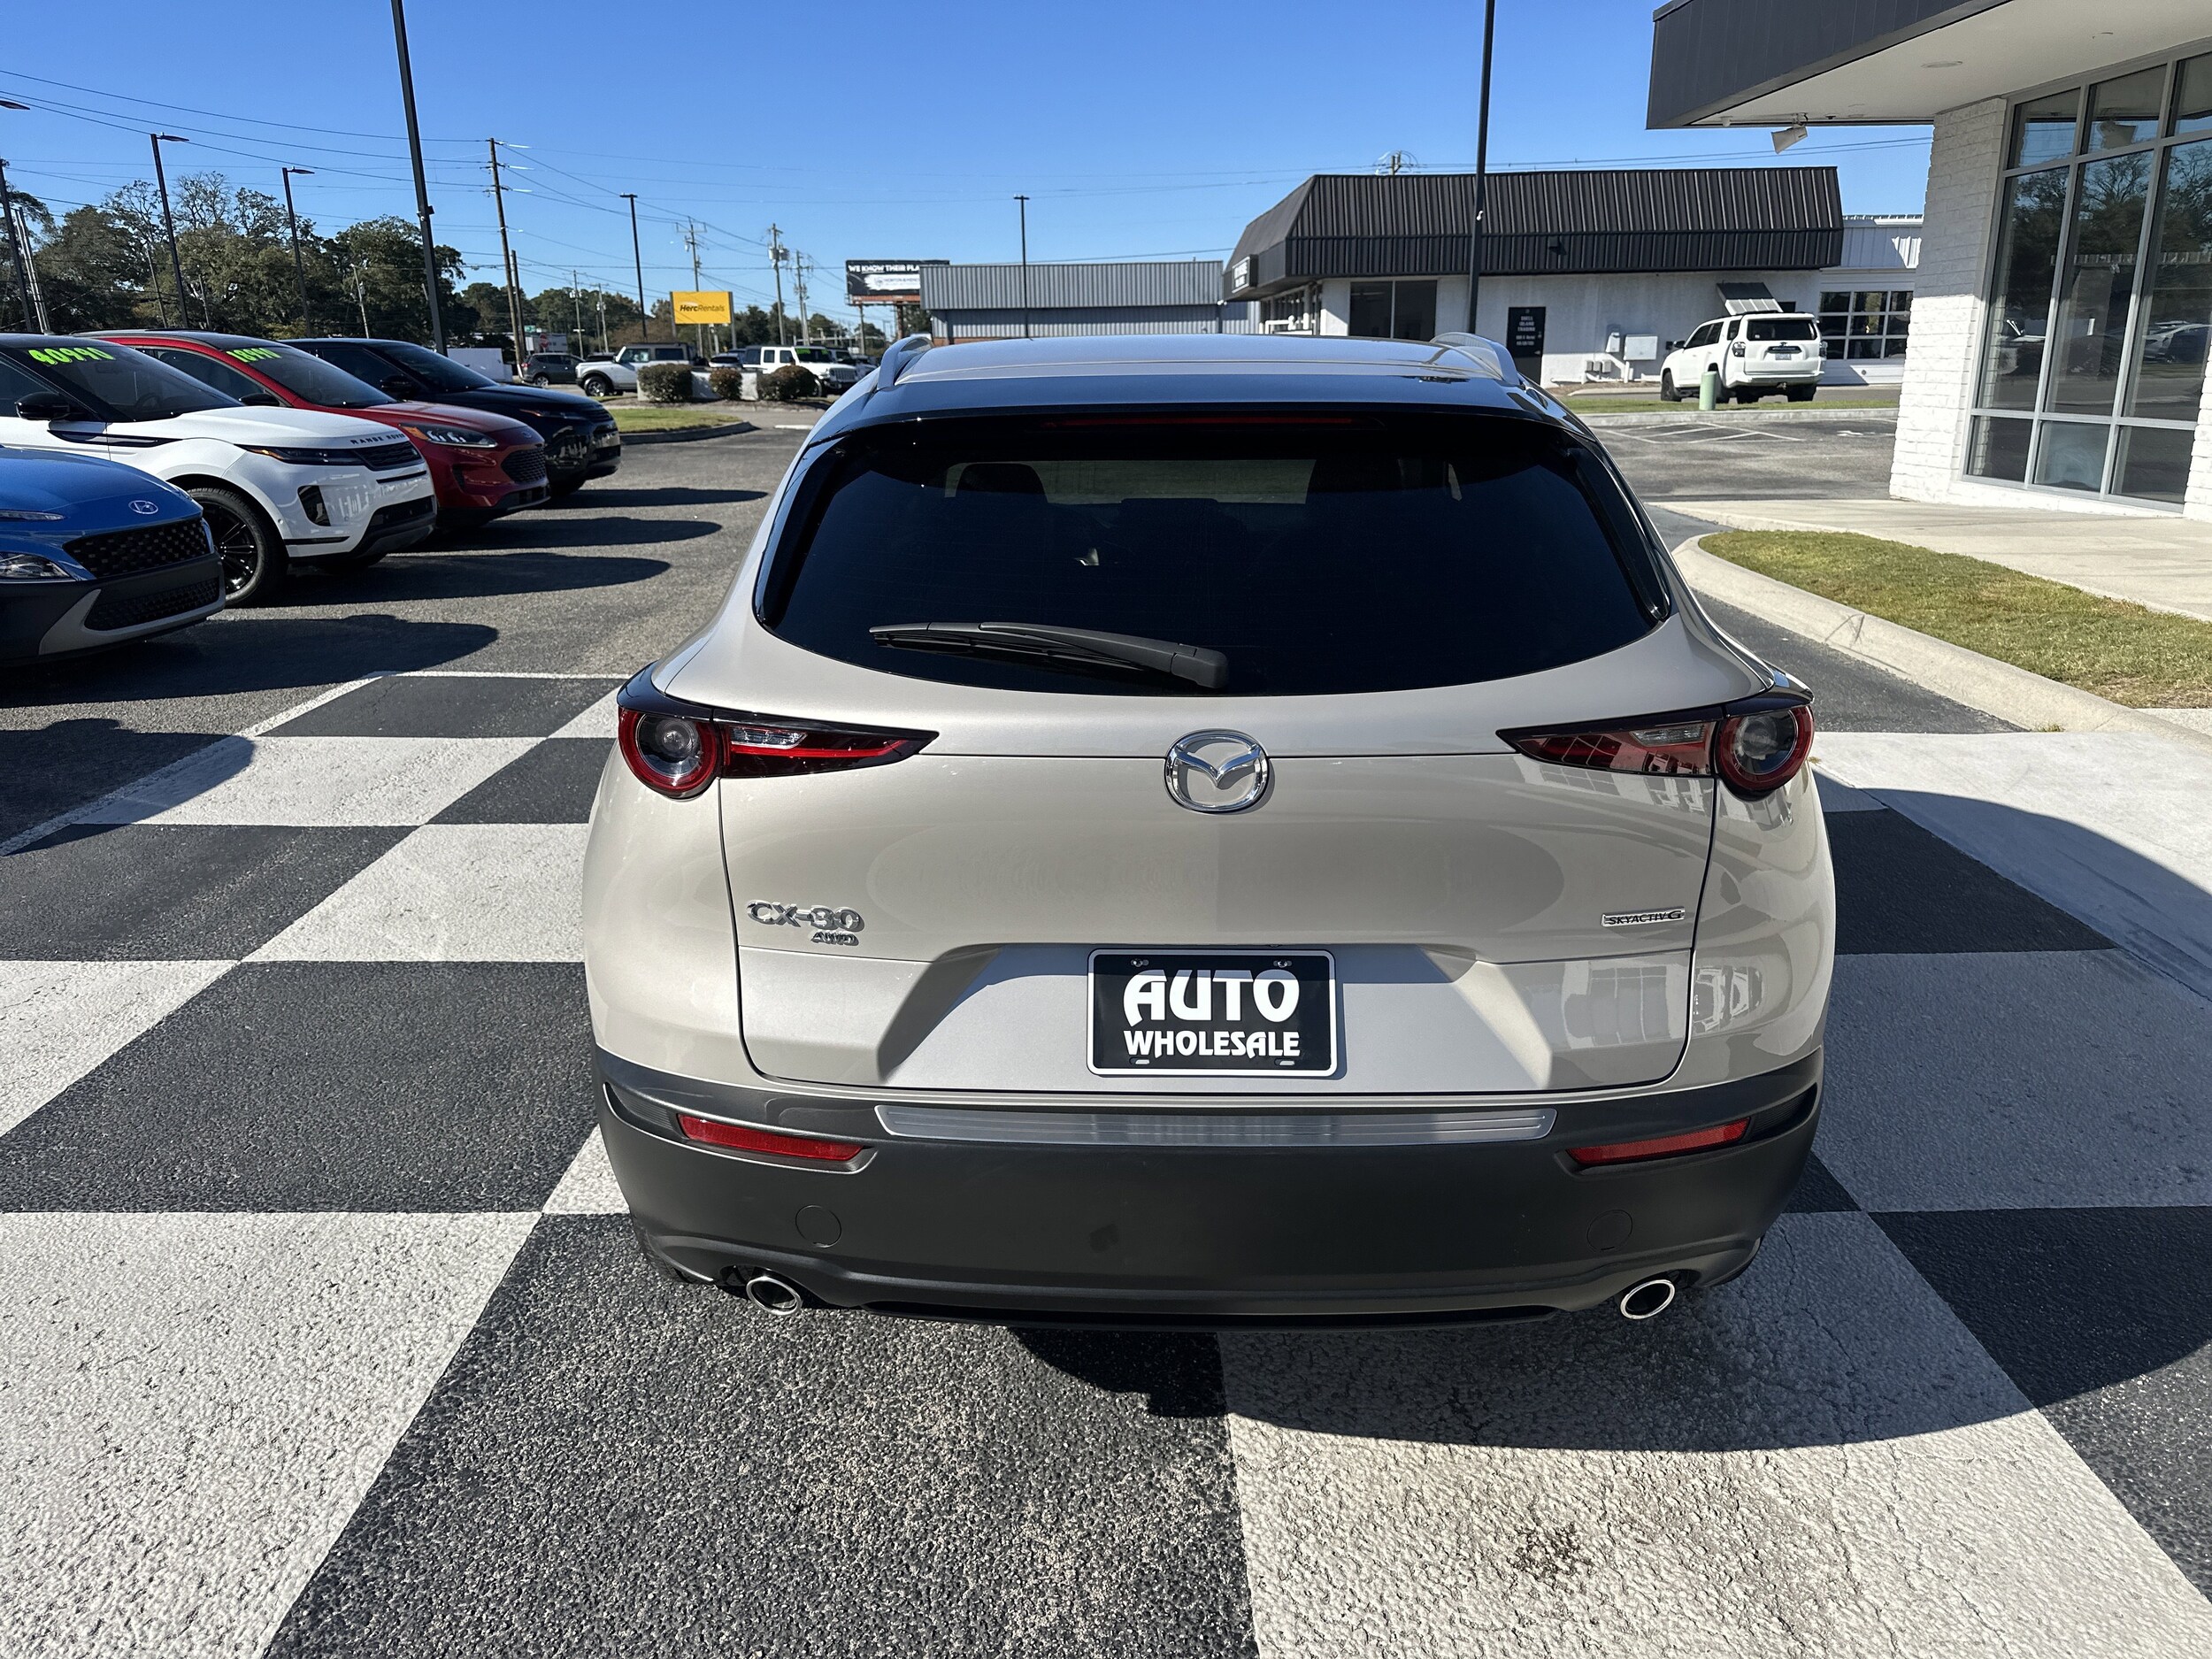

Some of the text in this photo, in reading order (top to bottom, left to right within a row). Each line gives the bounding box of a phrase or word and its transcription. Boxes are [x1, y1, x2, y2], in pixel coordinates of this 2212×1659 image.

[28, 347, 116, 365] 40990
[350, 436, 384, 445] RANGE
[747, 900, 864, 932] CX-30
[810, 929, 859, 946] AWD
[1123, 969, 1300, 1027] AUTO
[1123, 1031, 1301, 1059] WHOLESALE
